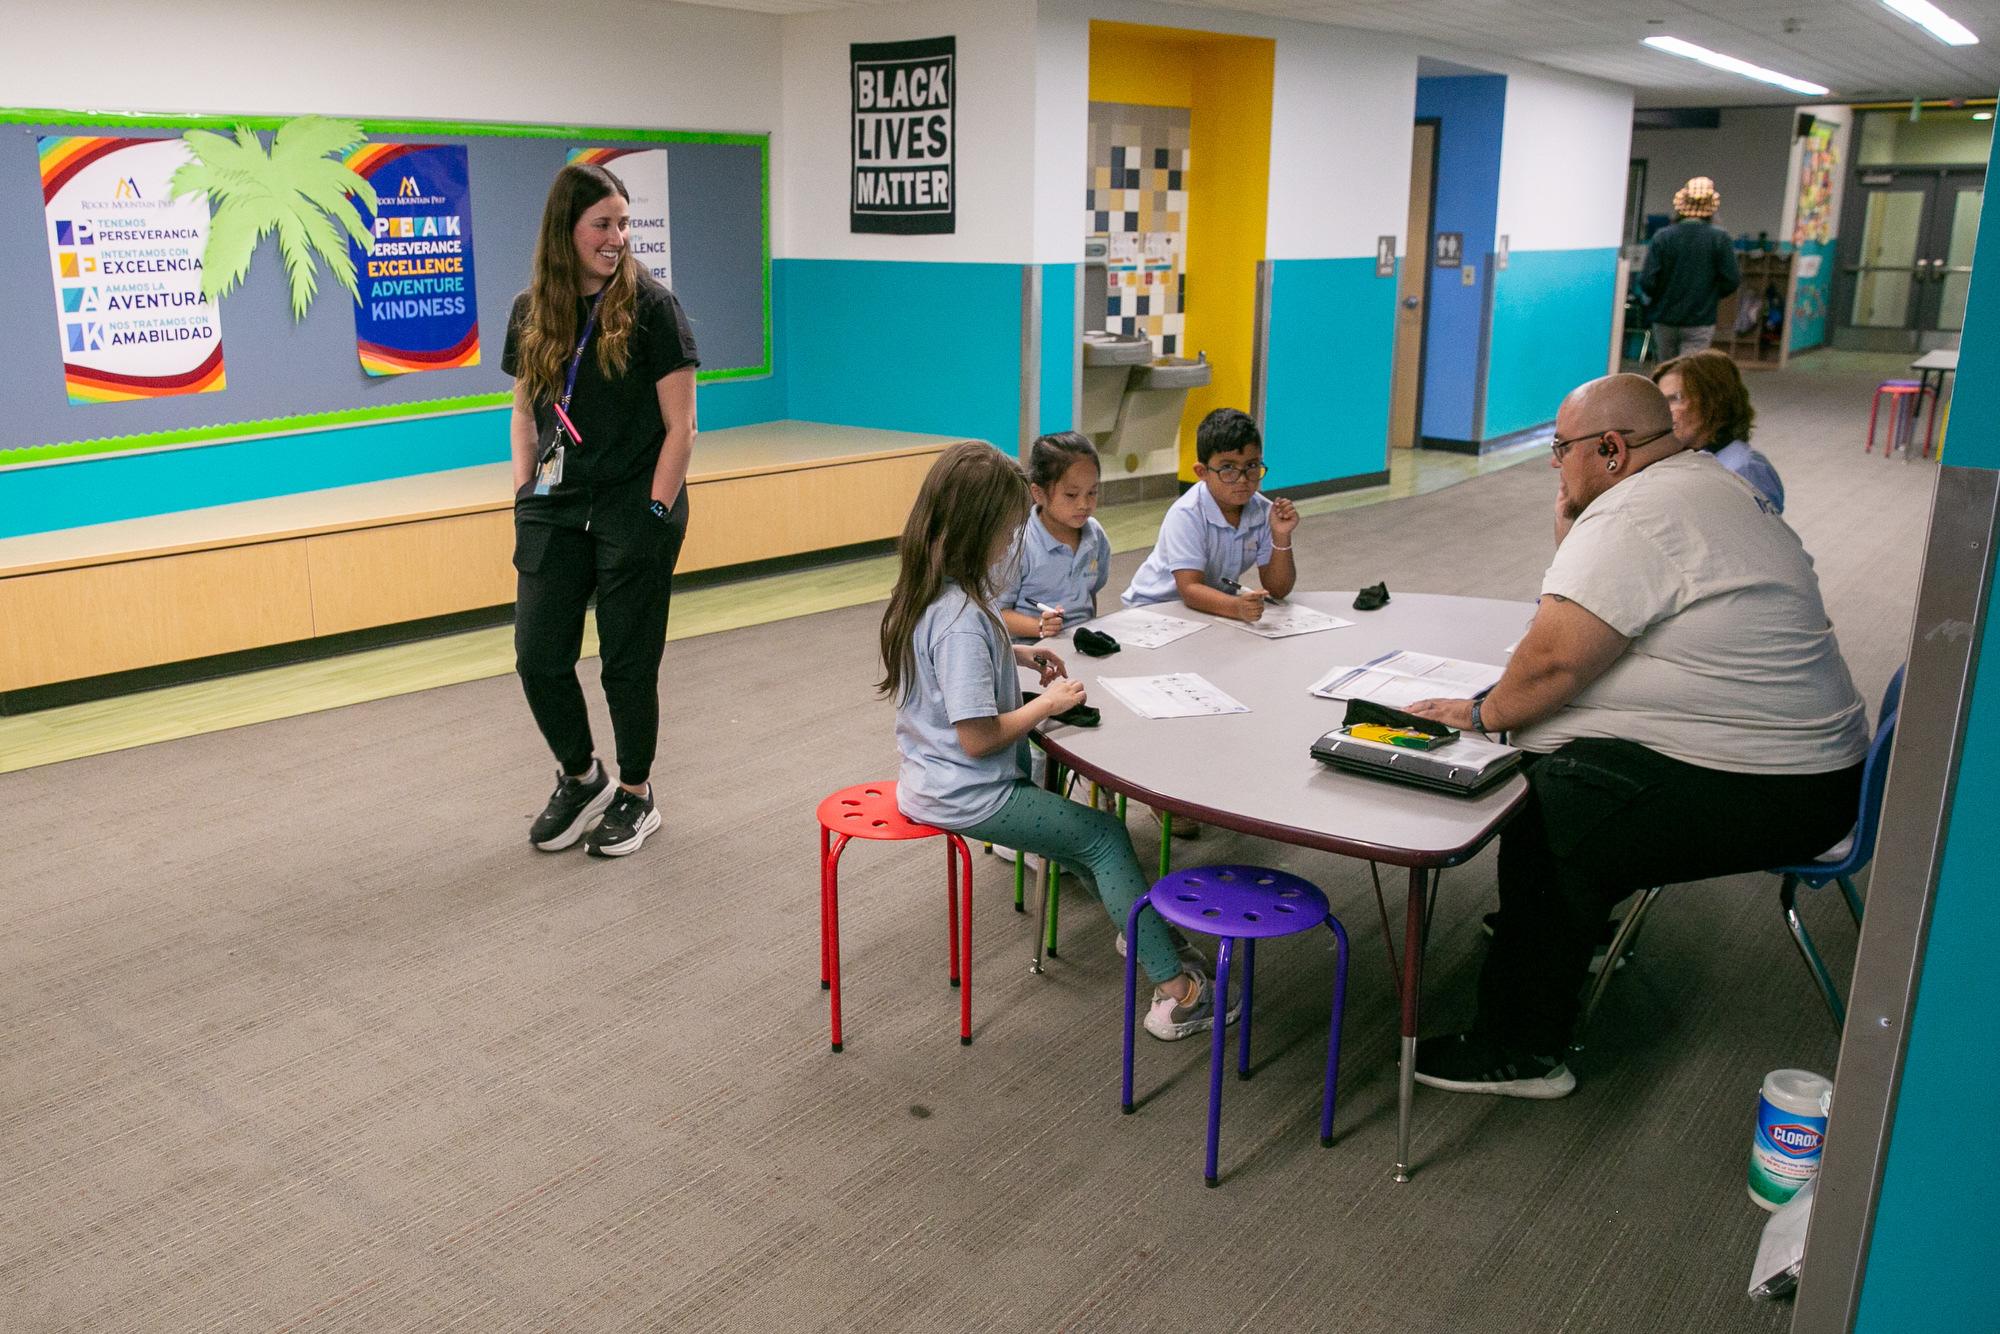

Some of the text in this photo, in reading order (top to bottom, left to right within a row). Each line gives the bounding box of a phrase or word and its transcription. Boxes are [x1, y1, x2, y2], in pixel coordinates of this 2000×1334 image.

[858, 65, 948, 108] BLACK
[858, 115, 948, 160] LIVES
[857, 170, 949, 205] MATTER
[97, 219, 146, 229] TENEMOS
[375, 216, 460, 239] PEAK
[100, 229, 199, 241] PERSEVERANCIA
[101, 247, 189, 260] INTENTAMOS CON
[632, 242, 666, 254] LENCE
[103, 258, 203, 274] EXCELENCIA
[368, 257, 463, 277] EXCELLENCE
[105, 282, 165, 293] AMAMOS LA
[371, 277, 465, 298] ADVENTURE
[108, 291, 208, 310] AVENTURA
[371, 296, 466, 321] KINDNESS
[109, 316, 208, 331] NOS TRATAMOS CON
[112, 326, 212, 346] AMABILIDAD
[1774, 1127, 1819, 1147] CLOROX
